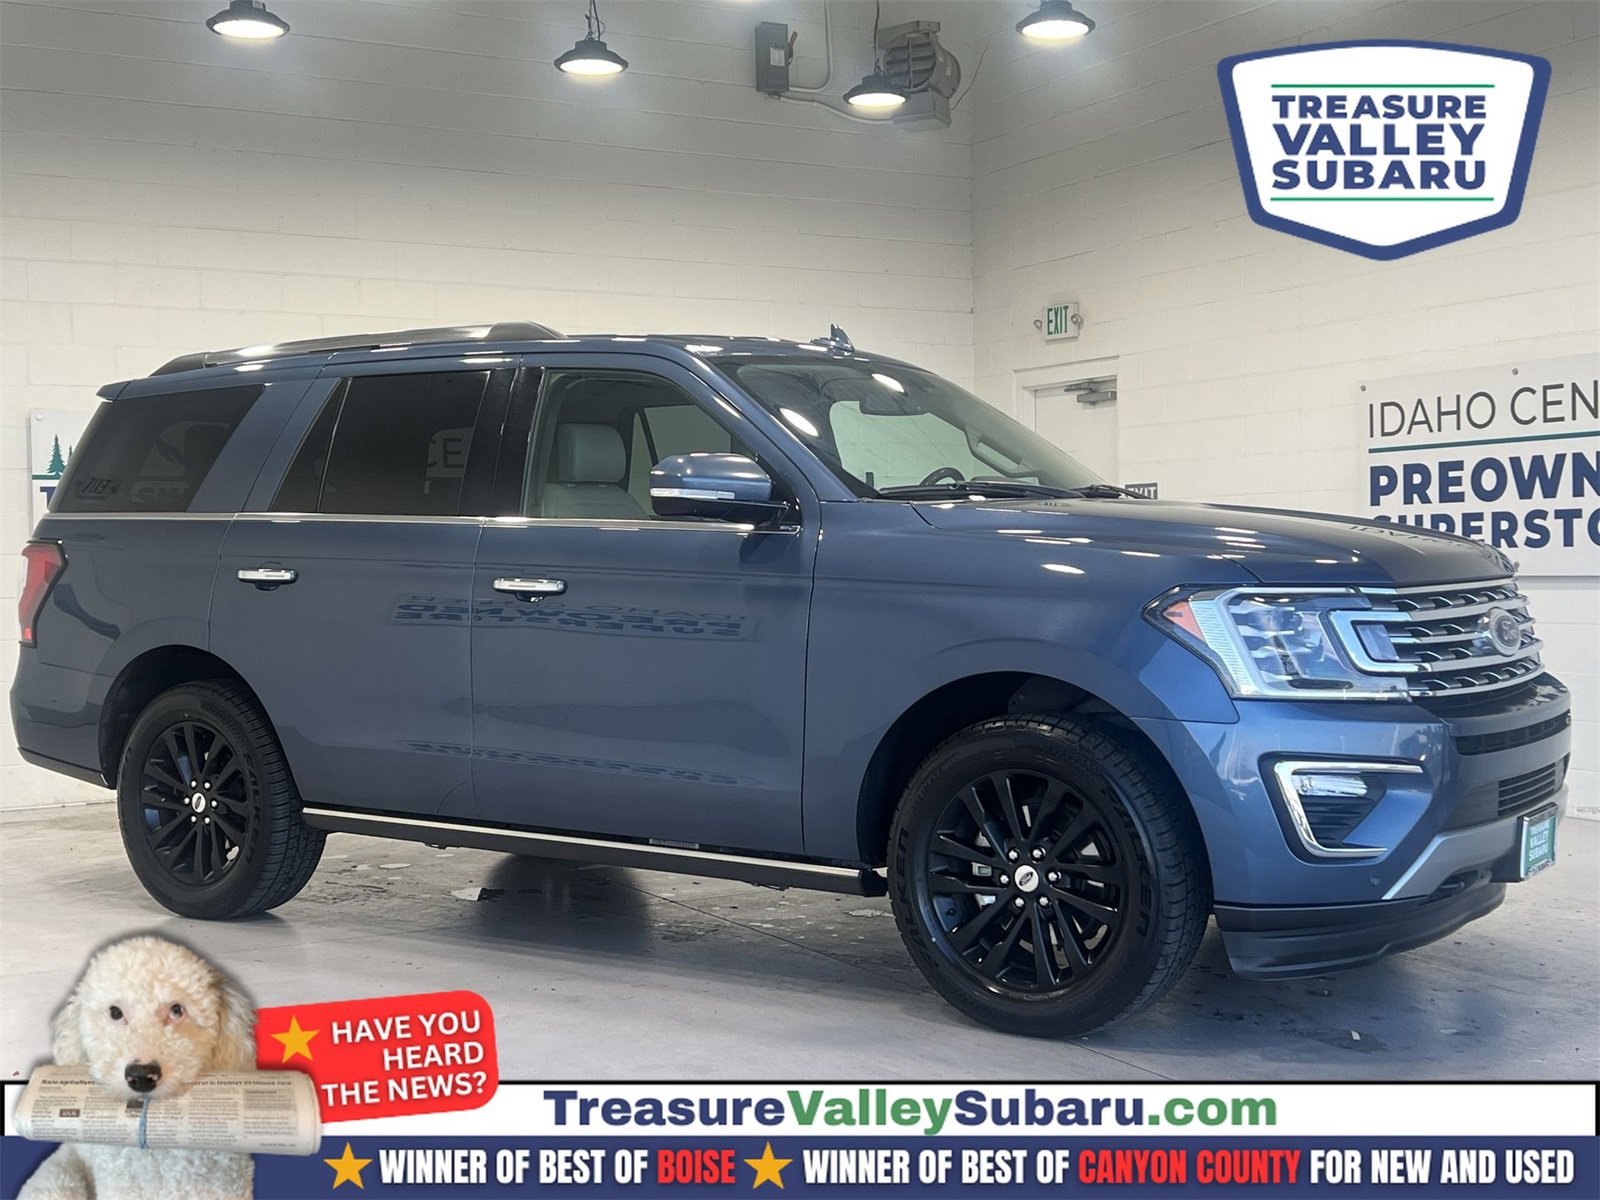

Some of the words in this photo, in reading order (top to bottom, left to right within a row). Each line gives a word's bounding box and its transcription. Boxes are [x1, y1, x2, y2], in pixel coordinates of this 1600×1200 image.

[1047, 306, 1069, 335] EXIT
[1369, 391, 1496, 438] IDAHO
[1510, 380, 1599, 425] CEN
[1370, 451, 1600, 507] PREOWN
